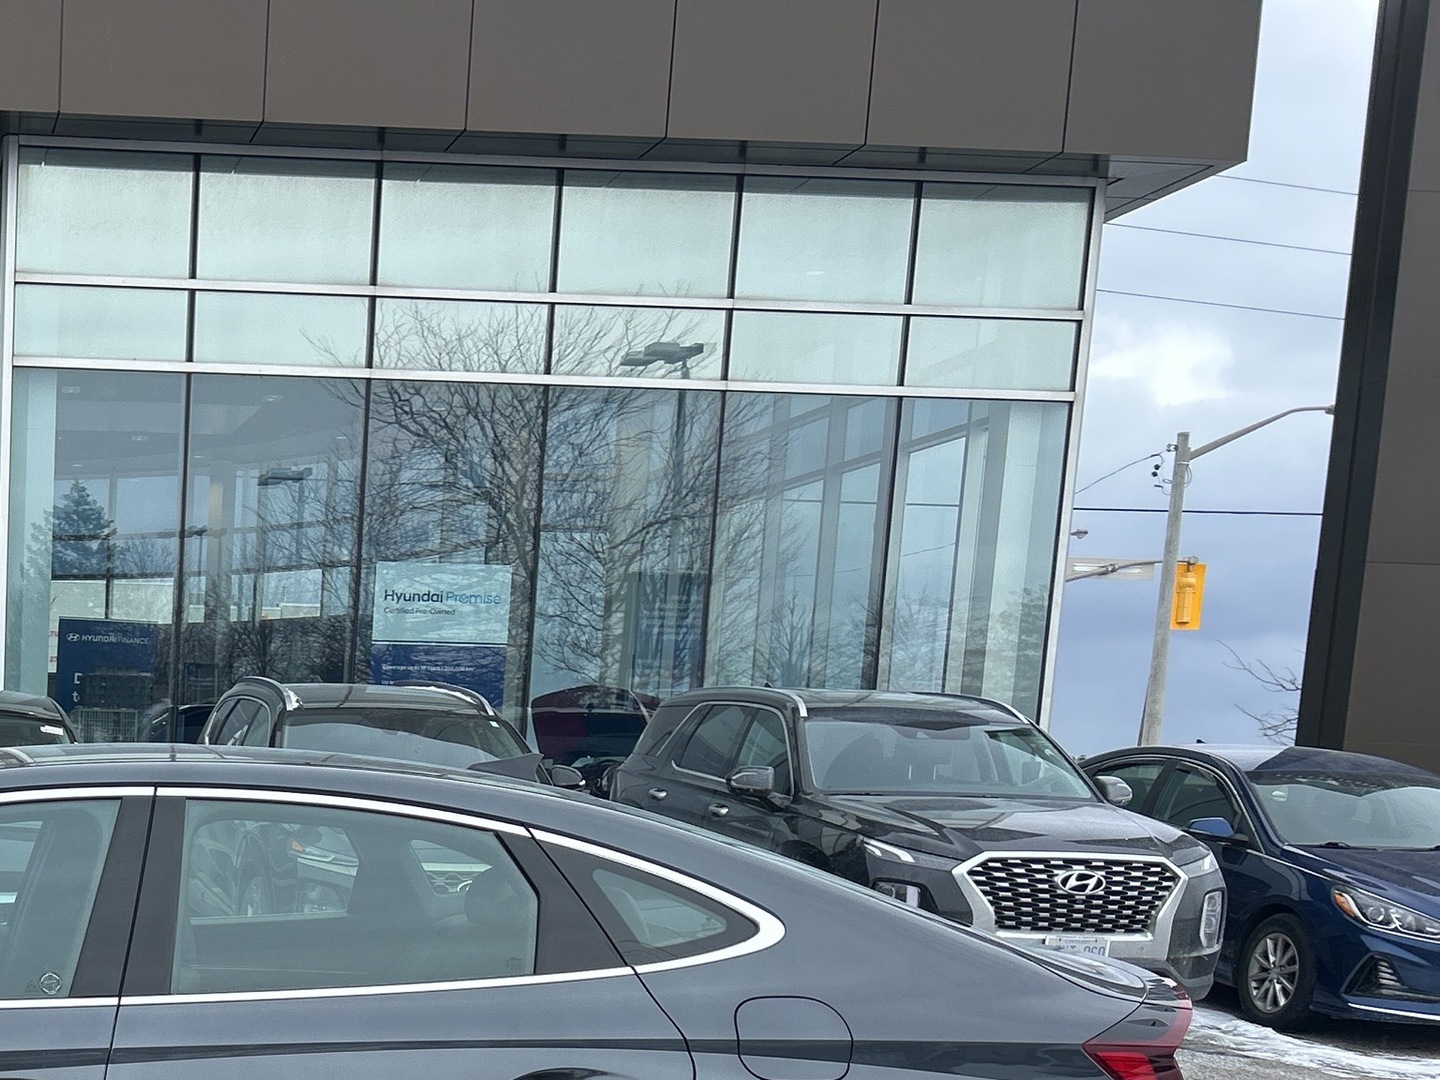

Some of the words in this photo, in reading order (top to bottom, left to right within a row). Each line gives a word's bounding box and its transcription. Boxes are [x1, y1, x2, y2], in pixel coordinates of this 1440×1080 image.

[384, 589, 443, 604] Hyundai
[445, 591, 502, 605] Promise
[384, 607, 414, 615] Certified
[81, 634, 117, 643] HYUNDAI
[117, 637, 150, 645] FINANCE
